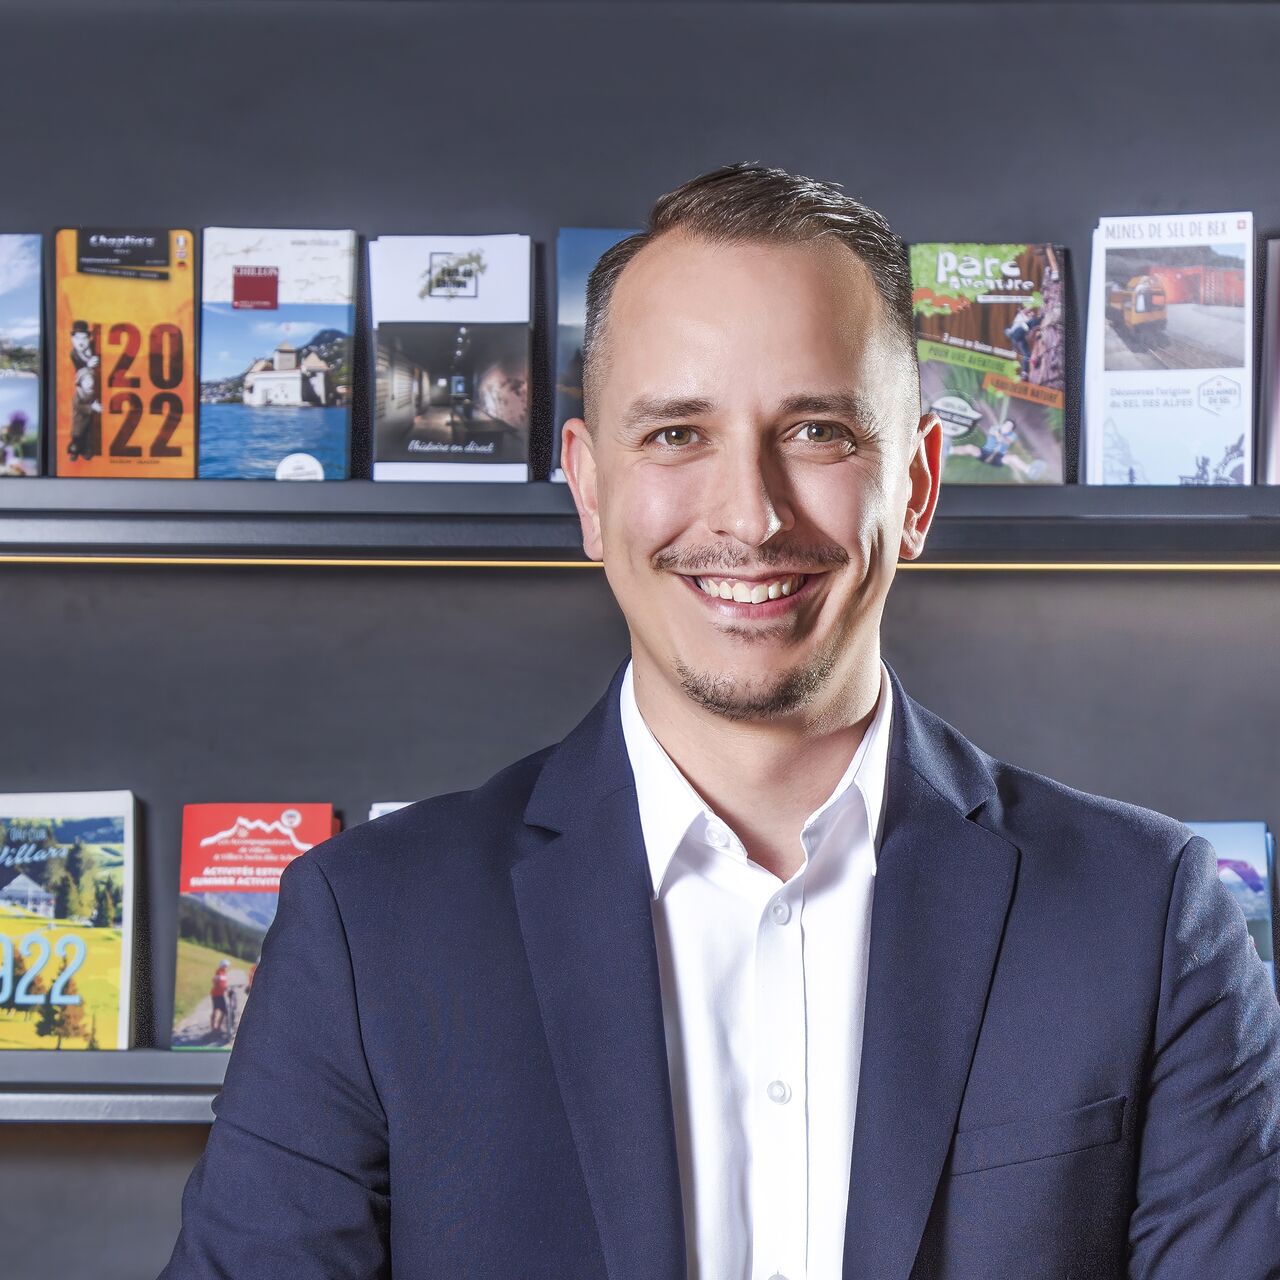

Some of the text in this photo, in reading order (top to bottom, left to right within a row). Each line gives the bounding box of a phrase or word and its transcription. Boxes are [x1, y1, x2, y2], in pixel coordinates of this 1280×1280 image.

[1104, 220, 1228, 241] MINES DE SEL DE BEX
[107, 322, 185, 390] 20
[108, 391, 185, 458] 22
